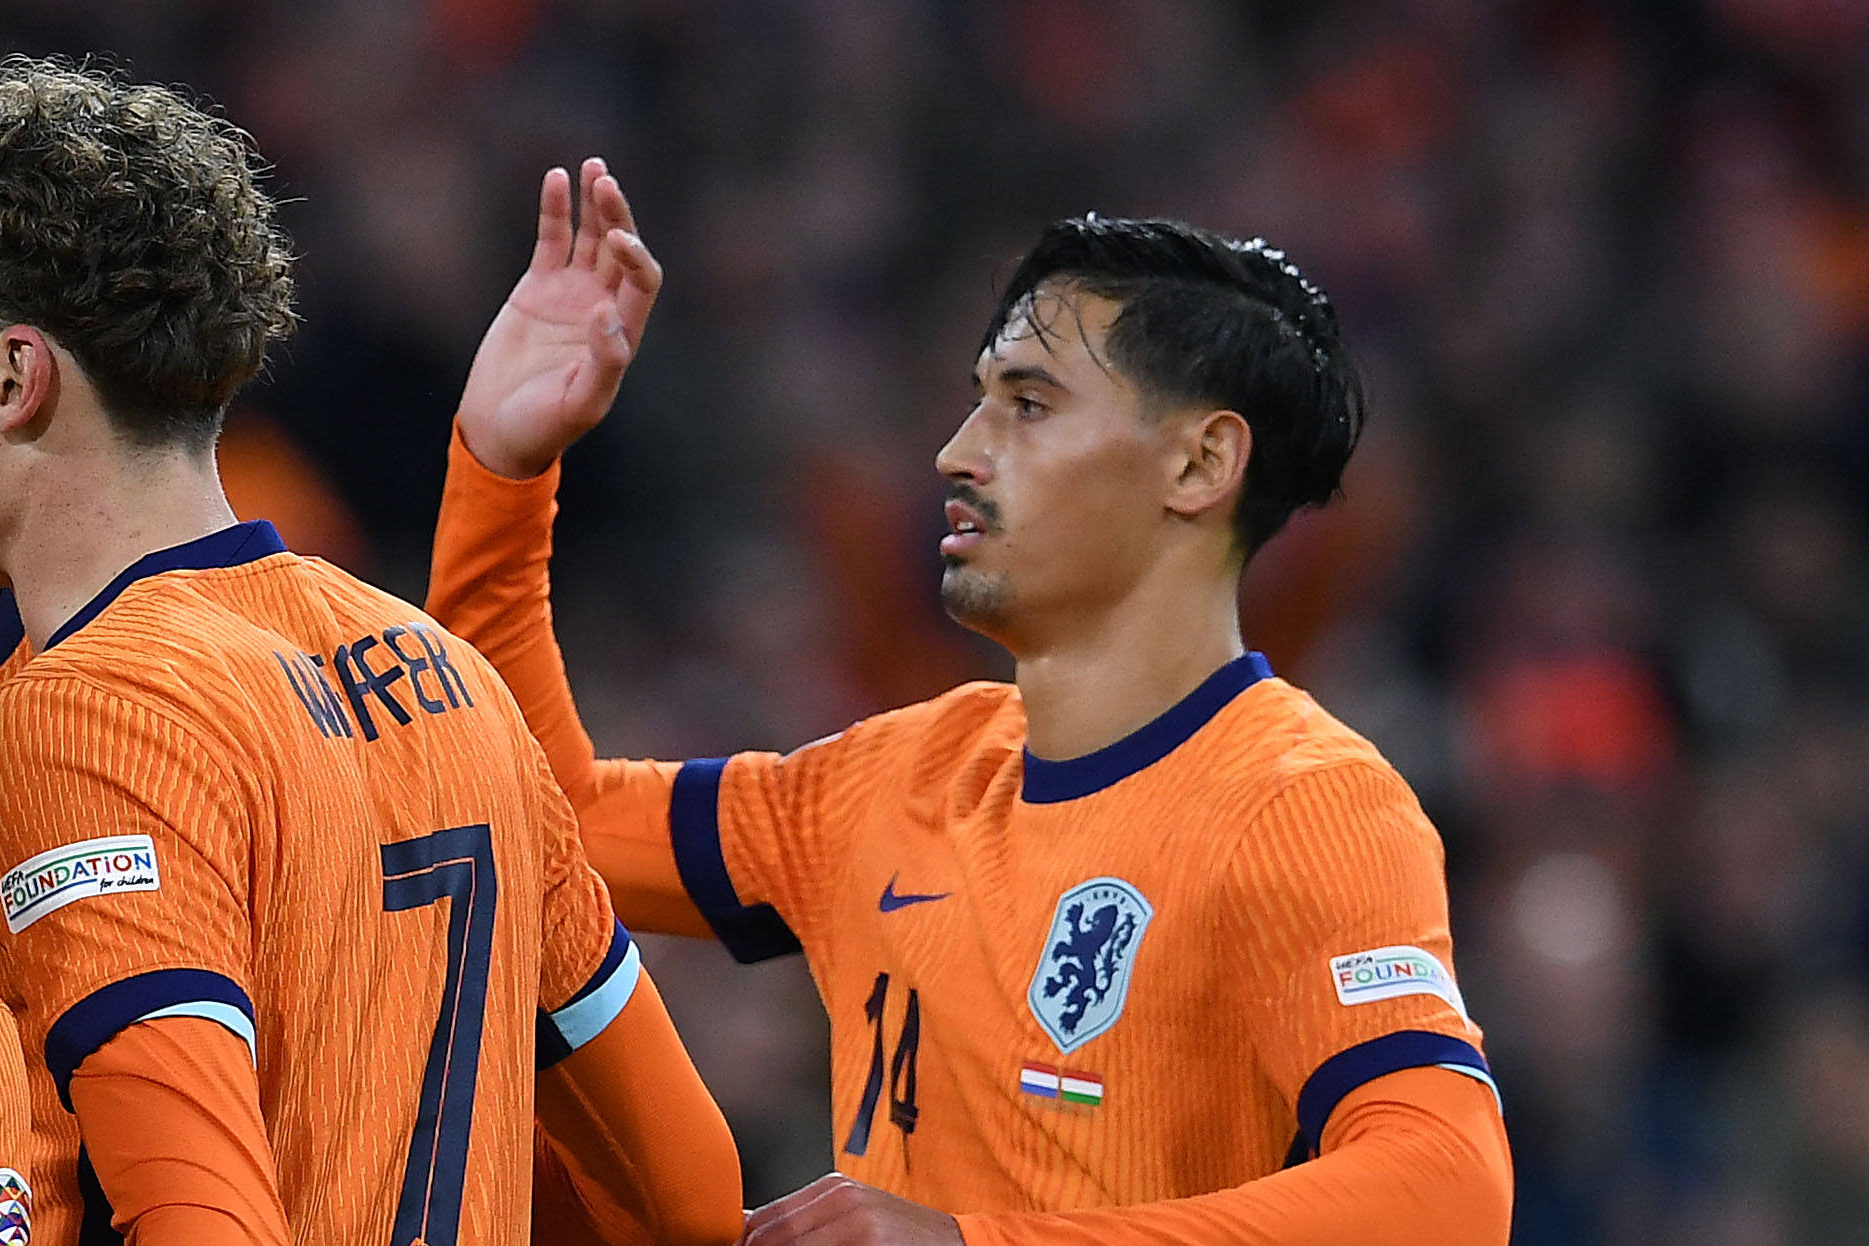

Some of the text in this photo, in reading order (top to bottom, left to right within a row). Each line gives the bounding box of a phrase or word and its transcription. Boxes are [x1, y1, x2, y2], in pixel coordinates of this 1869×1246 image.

[1, 870, 25, 894] UEFA
[99, 875, 155, 892] for children
[844, 971, 920, 1176] 14
